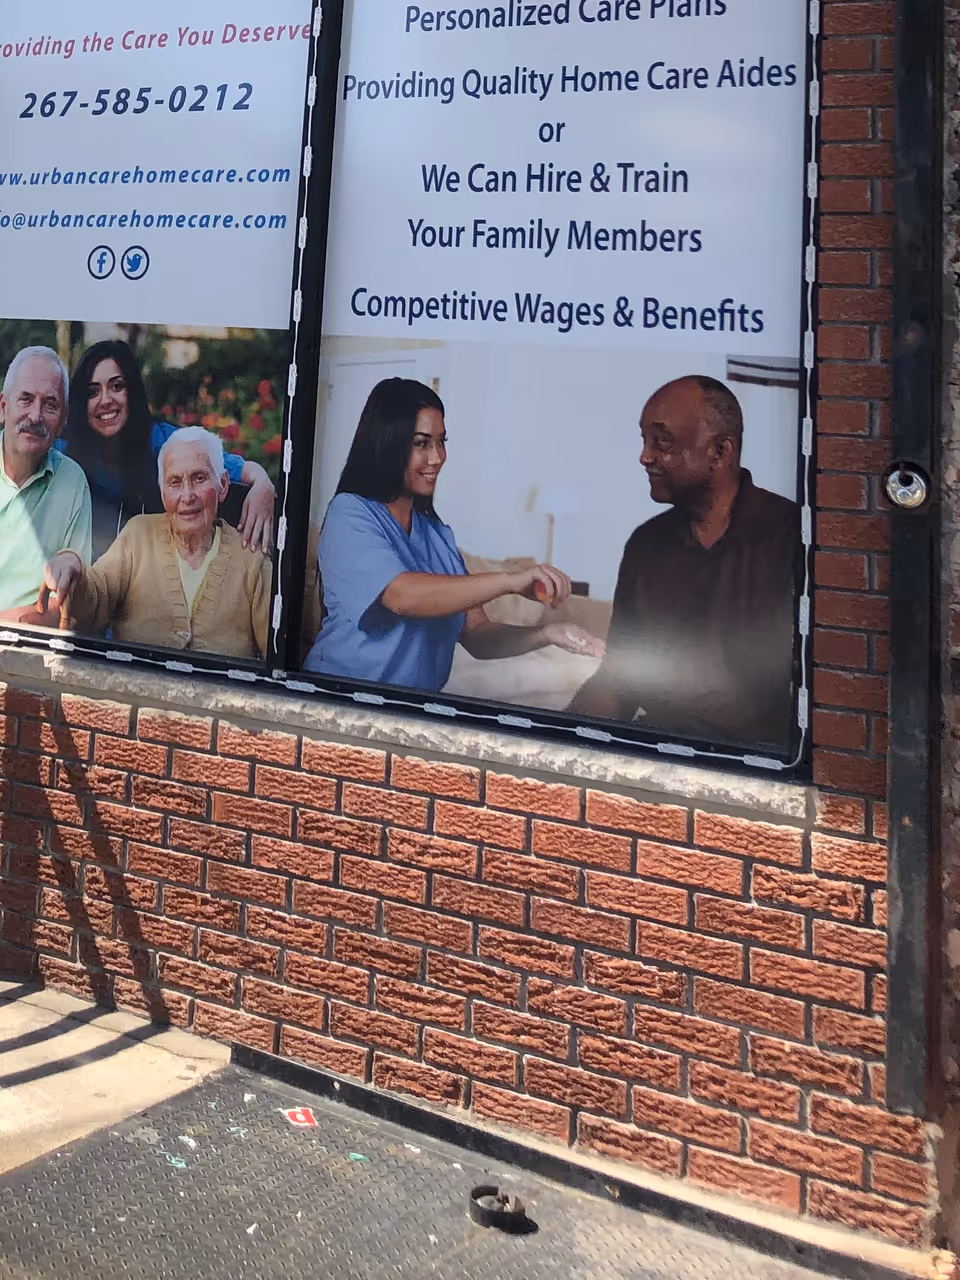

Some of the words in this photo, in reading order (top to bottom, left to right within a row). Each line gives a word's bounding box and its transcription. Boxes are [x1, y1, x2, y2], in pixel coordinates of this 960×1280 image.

[82, 32, 114, 53] the
[121, 31, 168, 51] Care
[177, 26, 215, 47] You
[222, 24, 311, 44] Deserve
[343, 71, 455, 104] Providing
[462, 66, 554, 101] Quality
[561, 65, 640, 93] Home
[647, 61, 709, 90] Care
[717, 57, 797, 88] Aides
[19, 82, 253, 119] 267-585-0212
[538, 122, 566, 142] or
[421, 164, 461, 193] We
[467, 163, 517, 193] Can
[526, 163, 582, 193] Hire
[589, 162, 611, 193] &
[616, 162, 689, 193] Train
[407, 218, 465, 248] Your
[472, 218, 560, 258] Family
[567, 220, 702, 253] Members
[351, 287, 508, 326] Competitive
[515, 292, 605, 333] Wages
[612, 296, 635, 328] &
[642, 297, 764, 333] Benefits
